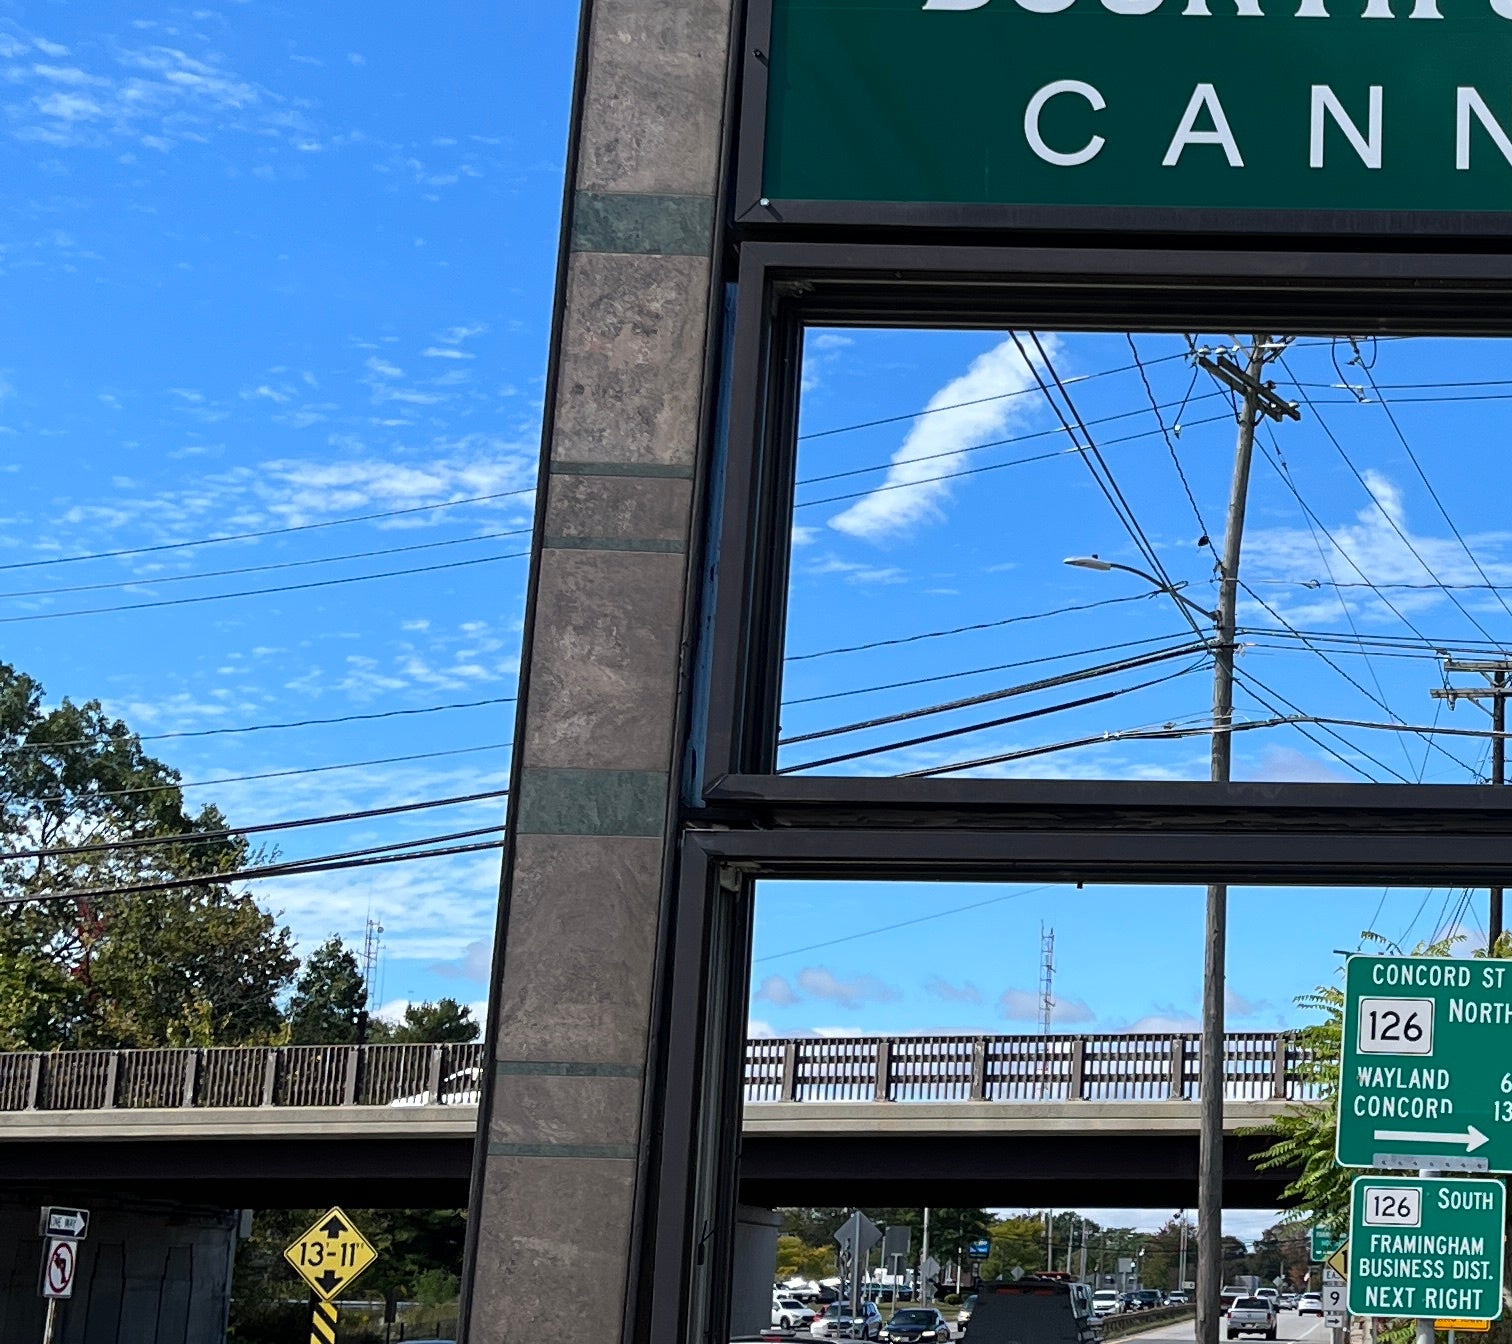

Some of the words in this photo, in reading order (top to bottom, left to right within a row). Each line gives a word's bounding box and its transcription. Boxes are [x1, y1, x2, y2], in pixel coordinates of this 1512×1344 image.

[1372, 964, 1471, 987] CONCORD
[1482, 968, 1506, 988] ST
[1369, 1010, 1423, 1042] 126
[1357, 1066, 1450, 1090] WAYLAND
[1500, 1072, 1512, 1094] 6
[1374, 1195, 1411, 1218] 126
[1437, 1187, 1494, 1210] SOUTH
[1370, 1234, 1484, 1256] FRAMINGHAM
[1359, 1258, 1445, 1279] BUSINESS
[1452, 1260, 1494, 1280] DIST.
[1330, 1291, 1340, 1306] 9
[1365, 1285, 1416, 1309] NEXT
[1425, 1287, 1484, 1311] RIGHT
